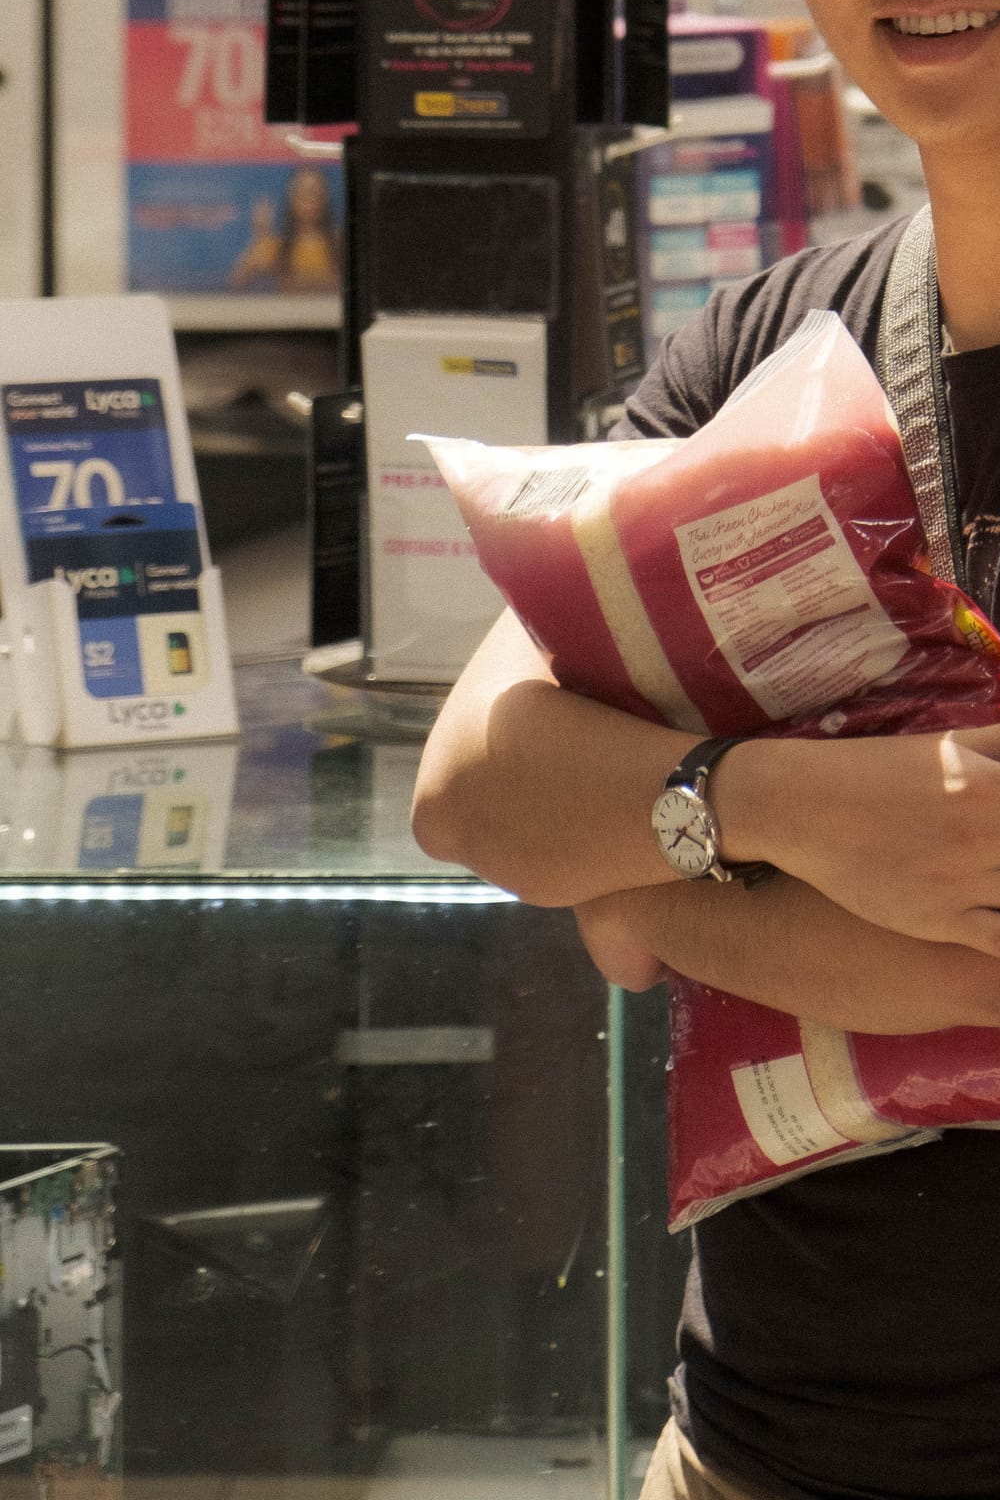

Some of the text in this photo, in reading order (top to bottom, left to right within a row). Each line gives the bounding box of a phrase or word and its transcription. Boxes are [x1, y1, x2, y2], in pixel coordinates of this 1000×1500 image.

[168, 26, 264, 107] 70
[84, 389, 142, 415] Lyca
[30, 457, 125, 510] 70
[107, 701, 169, 727] Lyca
